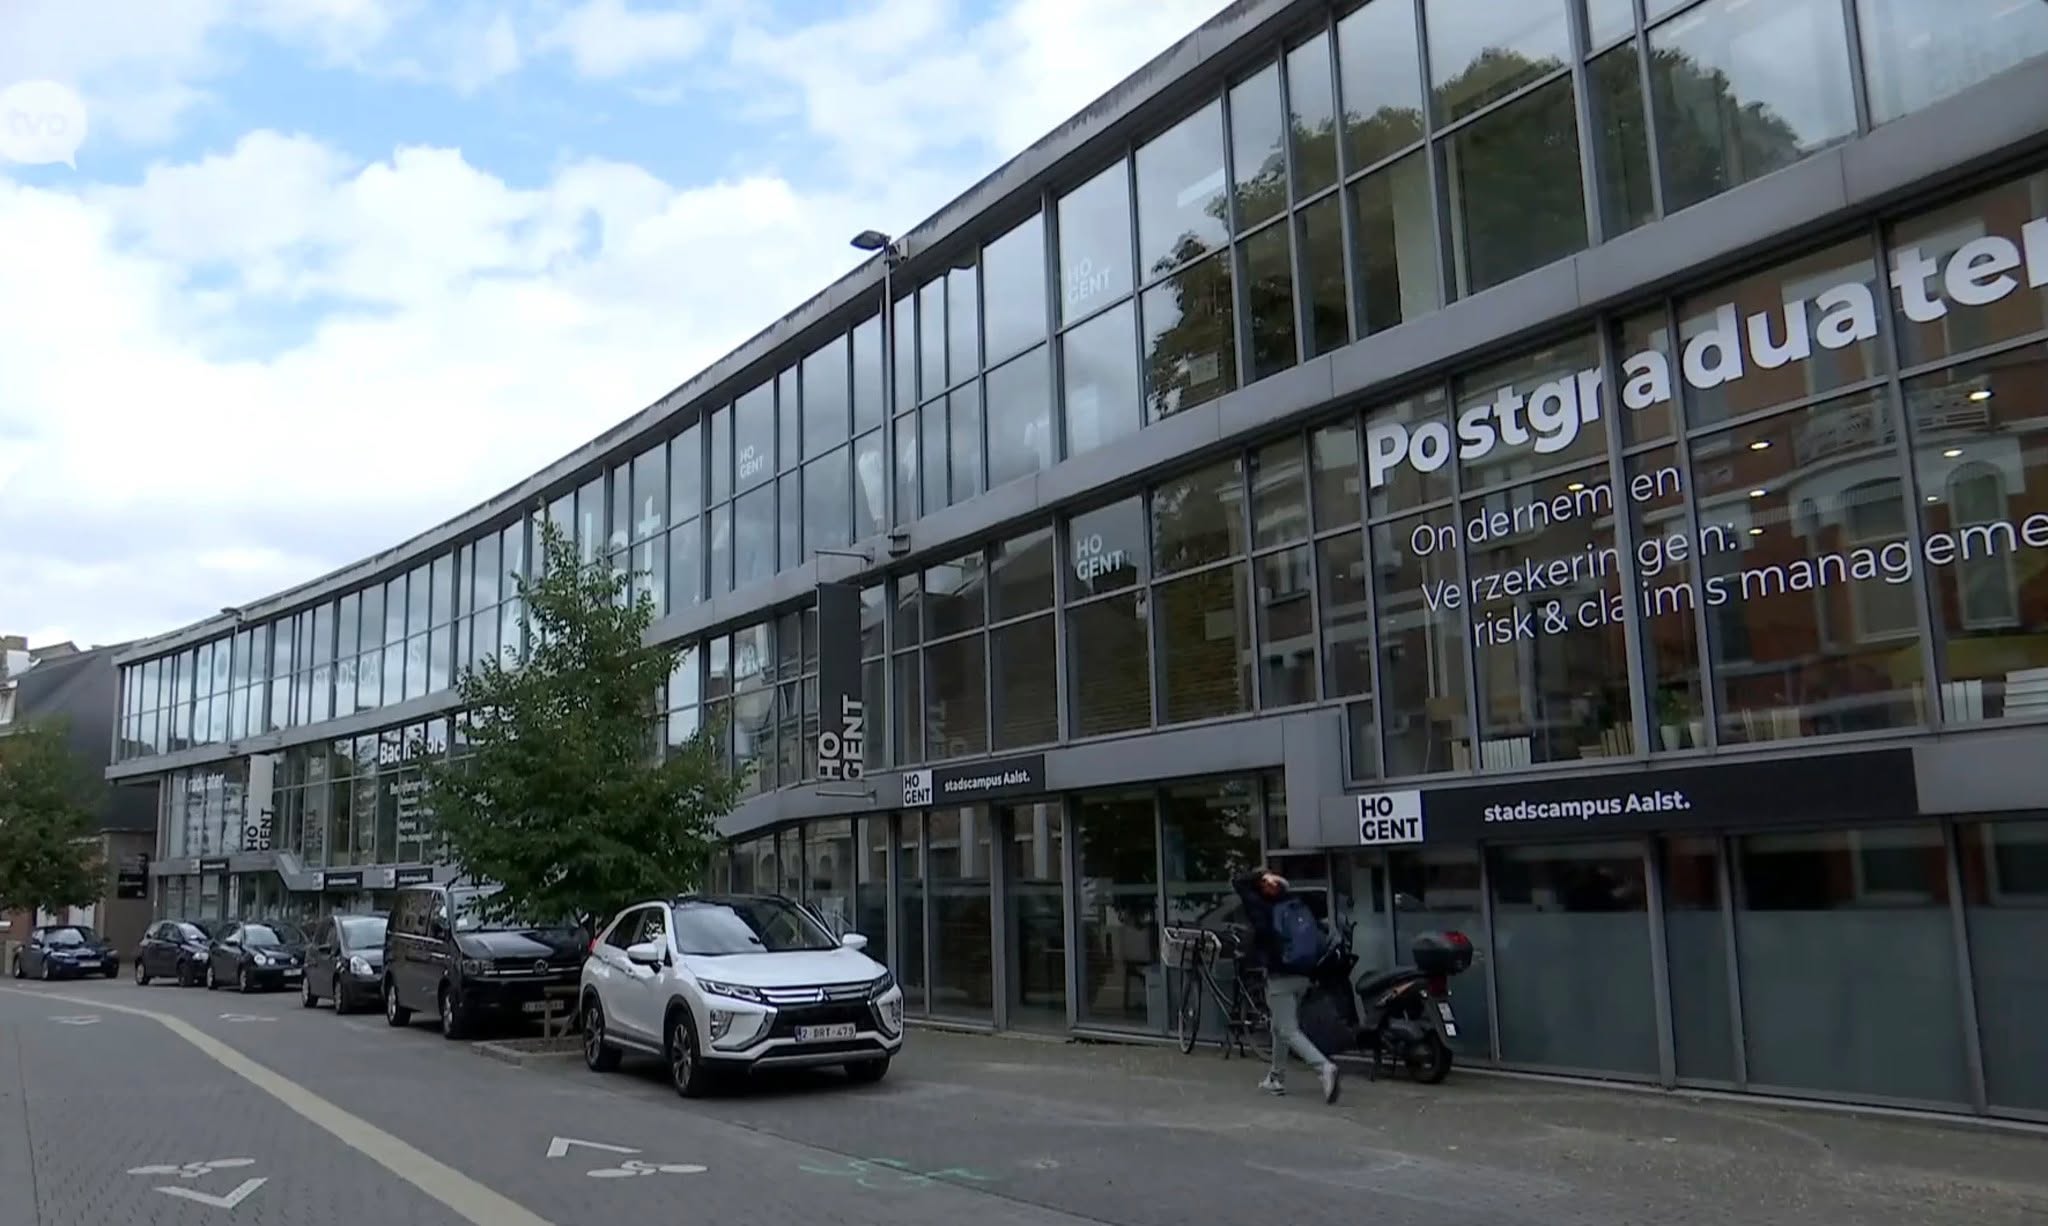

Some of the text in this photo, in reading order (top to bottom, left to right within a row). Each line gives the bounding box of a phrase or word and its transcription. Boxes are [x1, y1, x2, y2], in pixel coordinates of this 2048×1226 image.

[1077, 534, 1102, 560] HO
[1077, 549, 1123, 580] GENT
[1473, 605, 1535, 647] risk
[1543, 600, 1569, 634] &
[842, 694, 864, 780] GENT
[818, 731, 841, 780] HO
[904, 773, 920, 789] HO
[944, 769, 1031, 792] stadscampus Aalst.
[904, 788, 931, 805] GENT
[1361, 795, 1393, 818] HO
[1484, 790, 1692, 823] stadscampus Aalst.
[246, 825, 258, 851] HO
[260, 808, 273, 850] GENT
[1361, 817, 1420, 841] GENT
